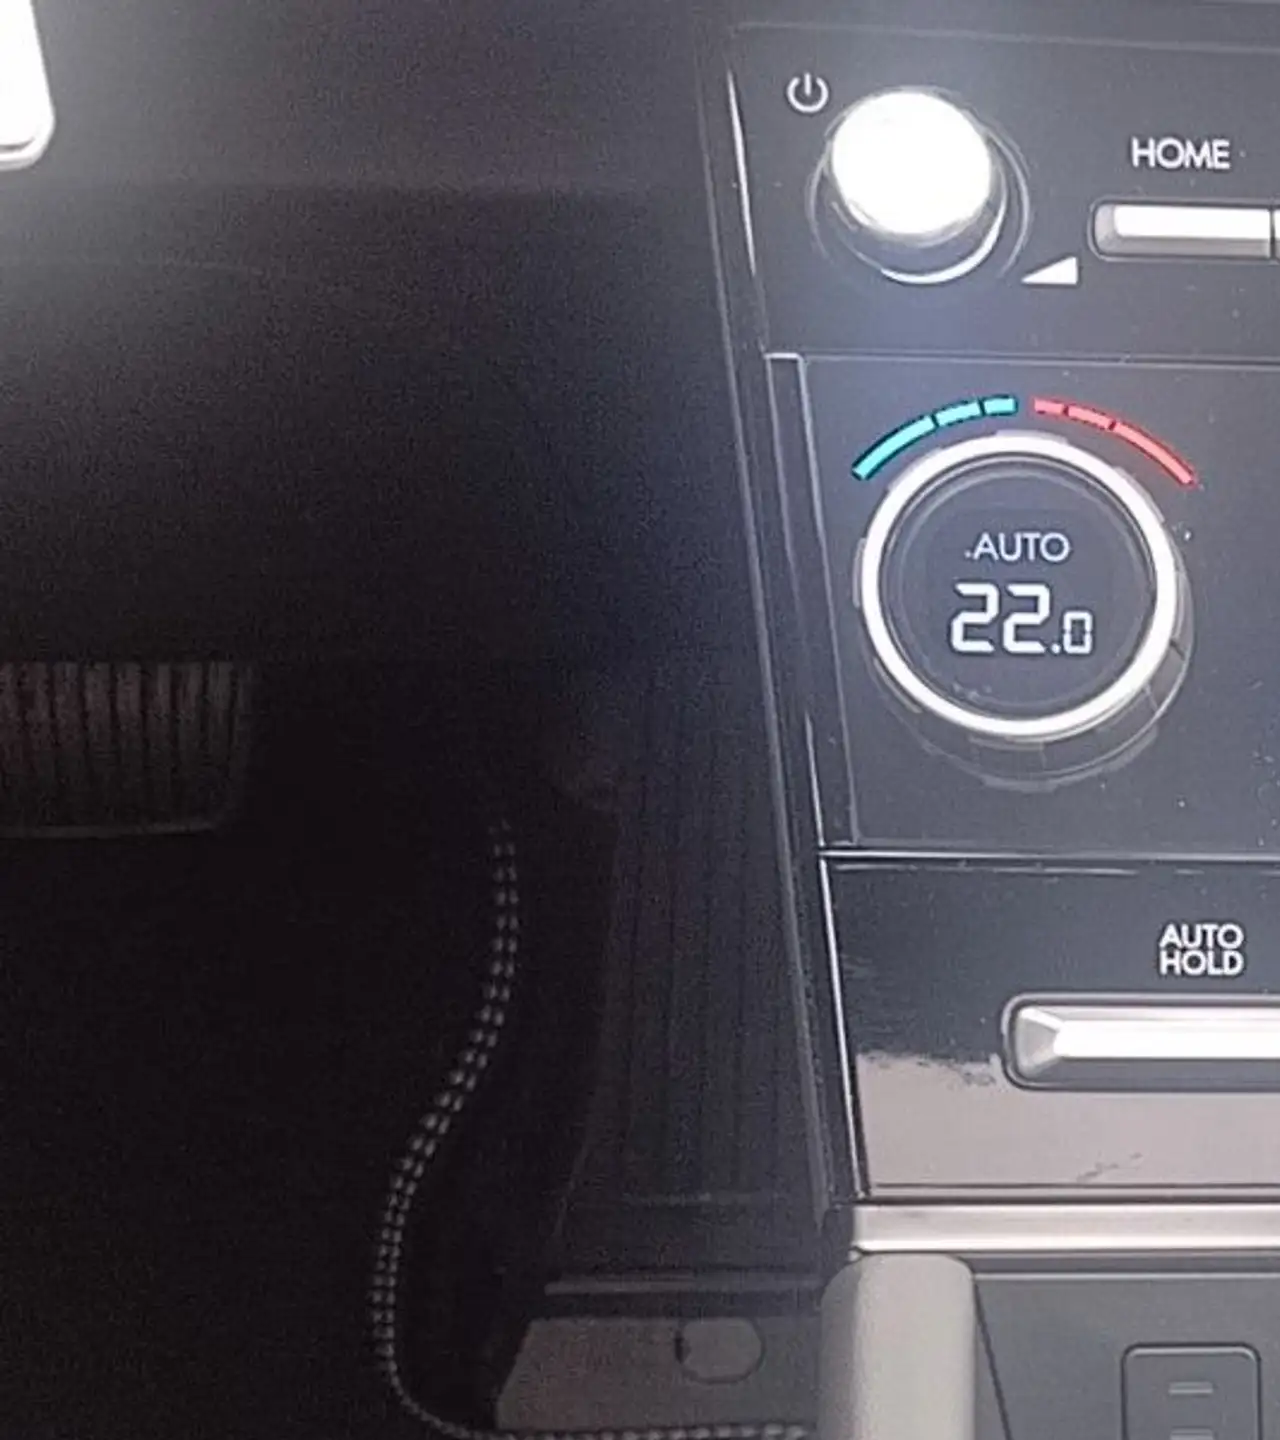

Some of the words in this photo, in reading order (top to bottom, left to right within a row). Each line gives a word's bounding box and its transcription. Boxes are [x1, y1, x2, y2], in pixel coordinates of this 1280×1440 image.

[1131, 137, 1230, 170] HOME
[972, 532, 1071, 563] AUTO
[950, 582, 1093, 655] 22.0
[1158, 923, 1245, 950] AUTO
[1158, 948, 1245, 977] HOLD
